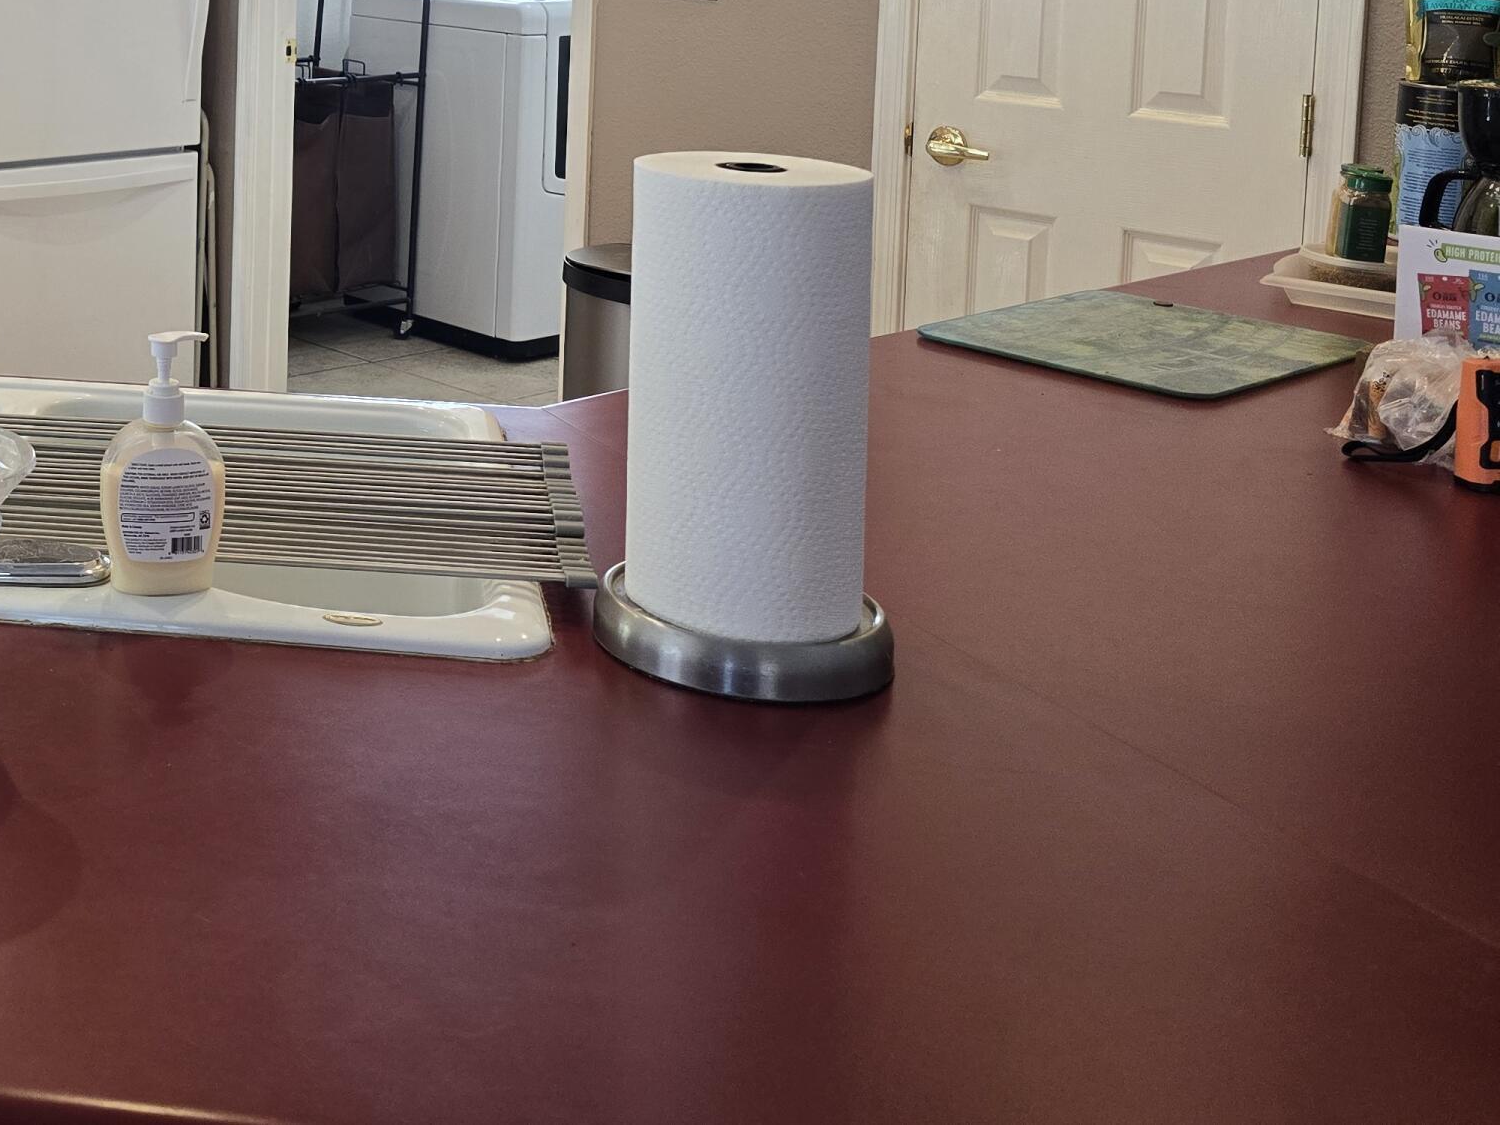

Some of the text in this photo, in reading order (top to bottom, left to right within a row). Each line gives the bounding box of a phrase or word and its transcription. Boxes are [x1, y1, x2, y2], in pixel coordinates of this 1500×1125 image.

[1445, 245, 1466, 258] HIGH
[1426, 308, 1467, 321] EDAMAME
[1433, 318, 1461, 331] BEANS
